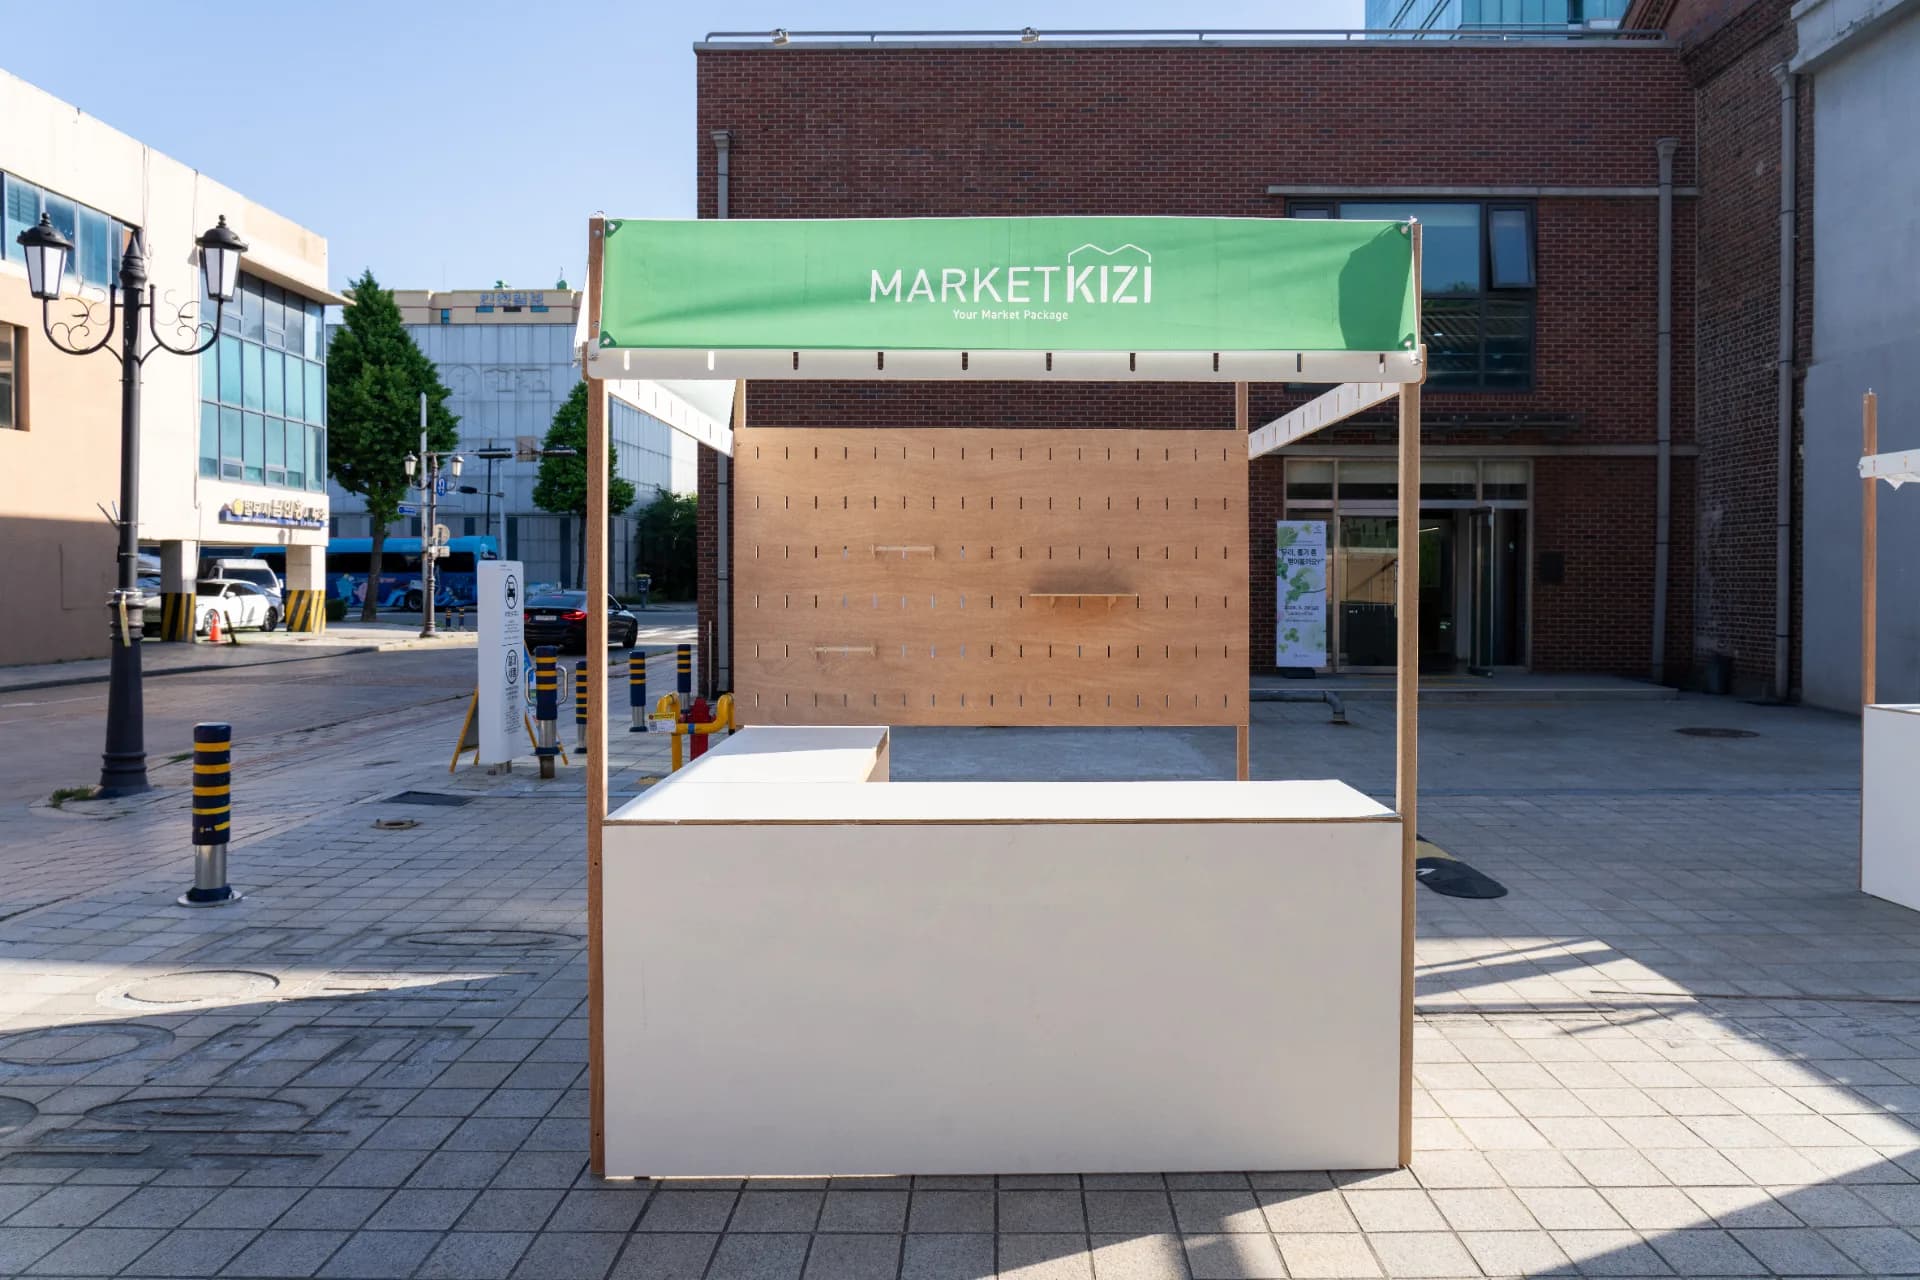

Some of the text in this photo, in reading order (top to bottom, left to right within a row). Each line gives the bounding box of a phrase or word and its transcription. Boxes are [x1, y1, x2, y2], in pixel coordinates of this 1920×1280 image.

[870, 266, 1151, 303] MARKETKIZI
[953, 309, 1069, 322] Your Market Package
